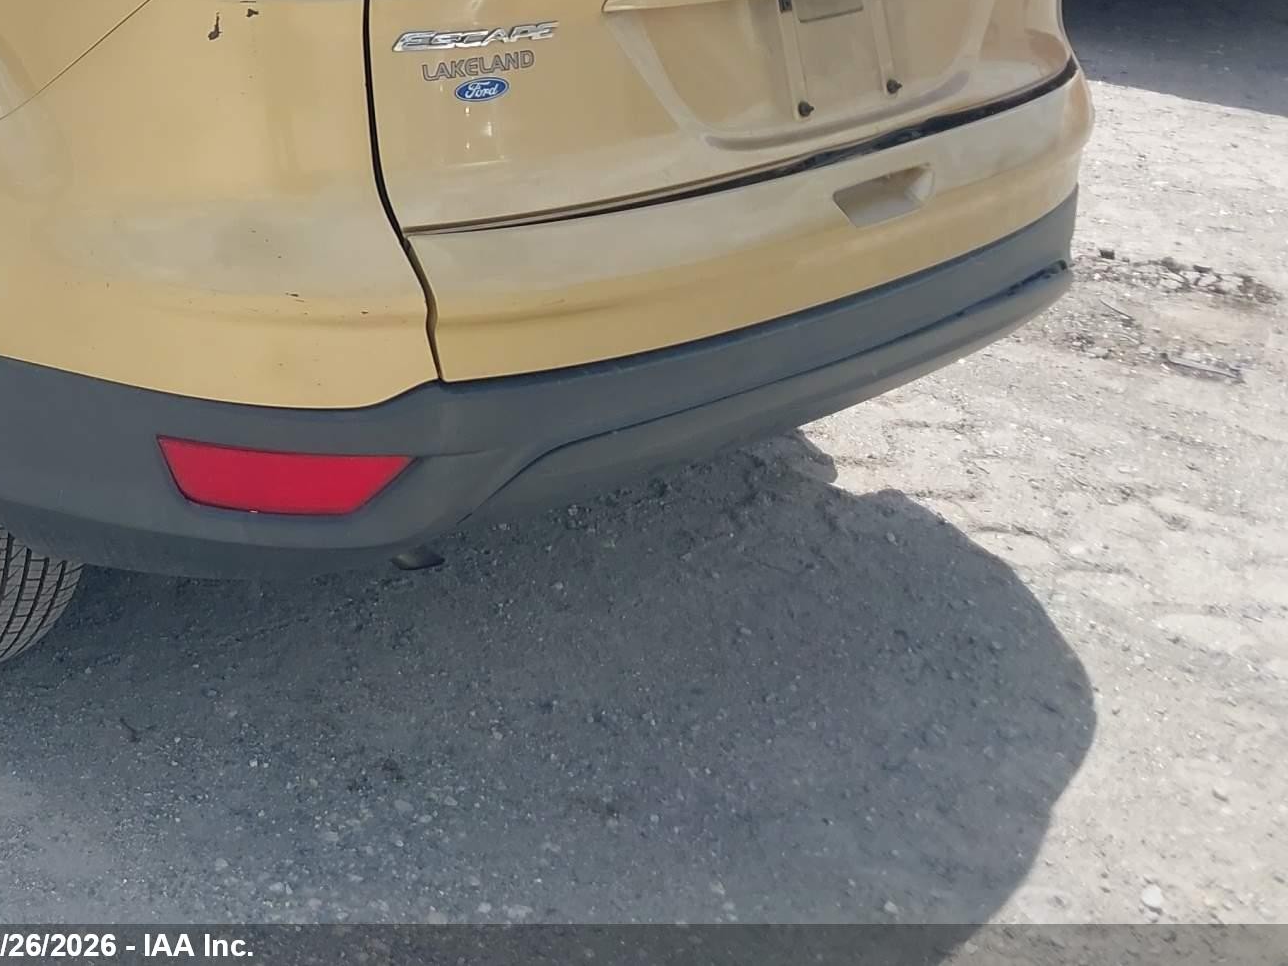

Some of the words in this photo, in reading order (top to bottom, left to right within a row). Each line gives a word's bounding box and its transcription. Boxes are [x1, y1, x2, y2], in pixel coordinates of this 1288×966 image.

[392, 20, 560, 52] ESCAPE
[422, 50, 535, 82] LAKELAND
[465, 81, 499, 99] Ford
